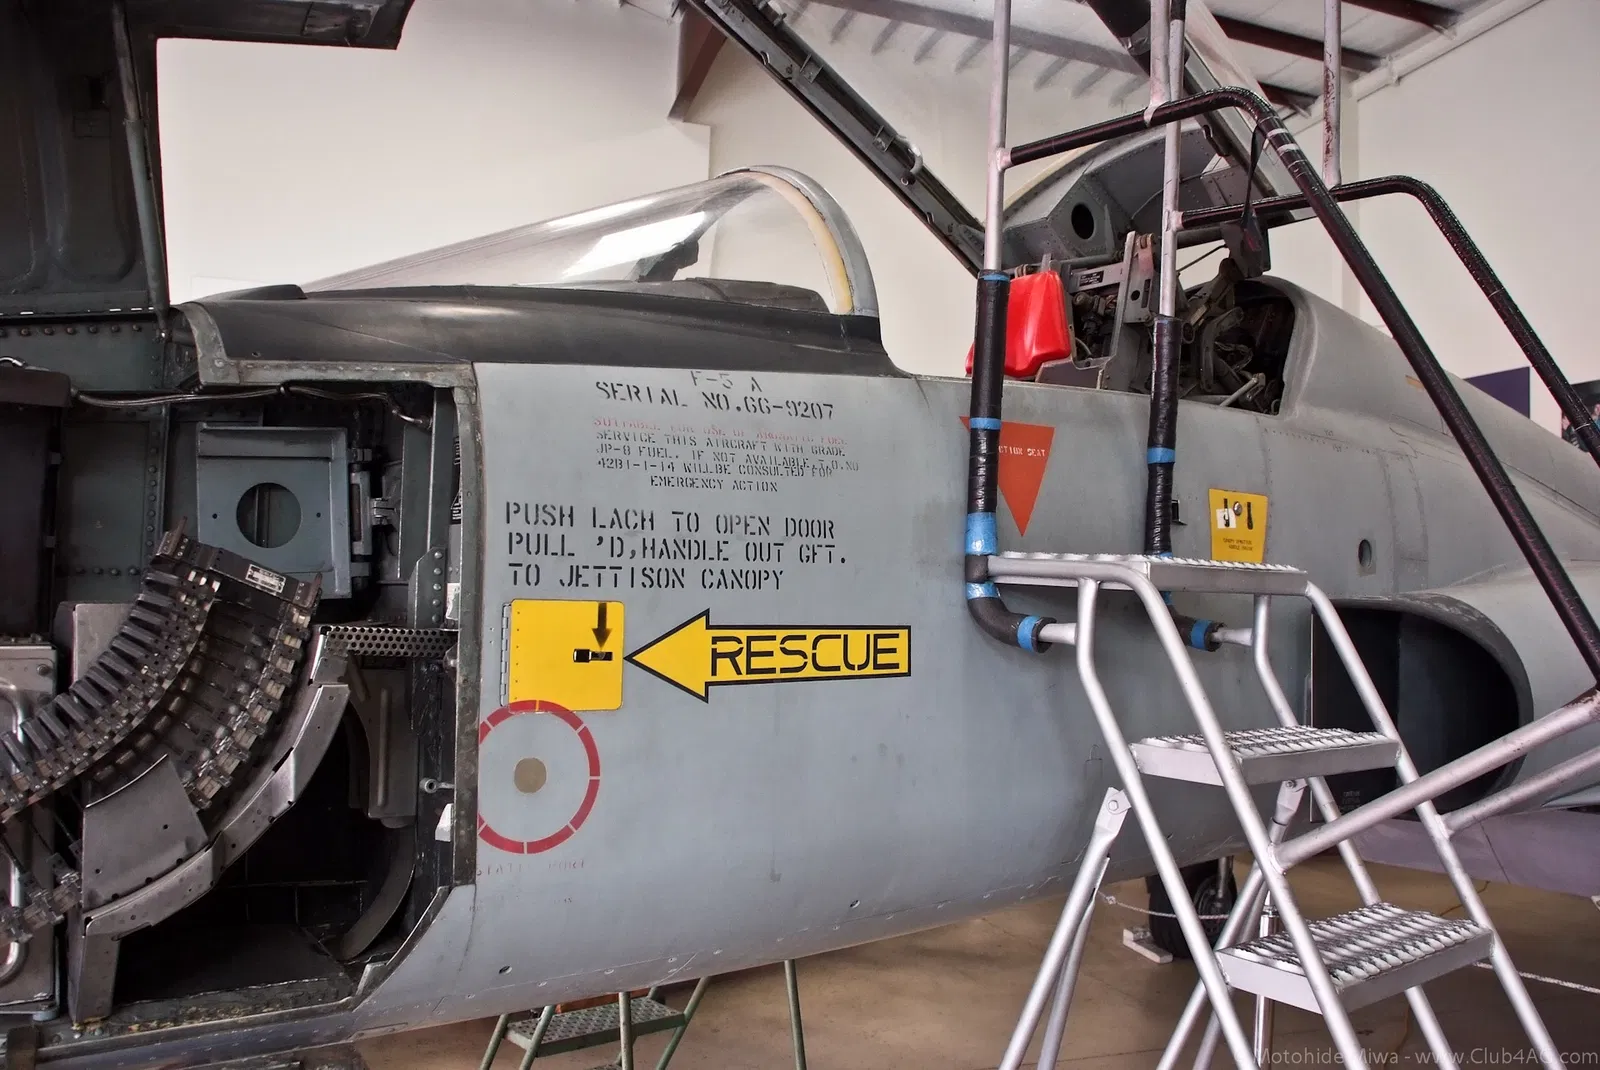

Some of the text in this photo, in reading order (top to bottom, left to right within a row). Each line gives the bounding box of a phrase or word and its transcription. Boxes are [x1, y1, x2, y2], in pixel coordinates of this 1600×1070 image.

[595, 381, 688, 408] SERIAL
[691, 370, 763, 393] F-5 A
[596, 430, 846, 457] SERVICE THIS AIRCRAFT WITH GRADE
[596, 443, 631, 456] JP-8
[692, 450, 705, 460] IF
[713, 451, 736, 463] NOT
[1026, 448, 1046, 458] SEAT
[650, 475, 779, 492] EMERGENCY ACTION
[738, 464, 805, 477] CONSULTED
[506, 501, 835, 540] PUSH LACH TO OPEN DOOR
[509, 532, 576, 556] PULL
[745, 542, 785, 563] OUT
[508, 562, 784, 591] TO JETTISON CANOPY
[711, 633, 900, 676] RESCUE
